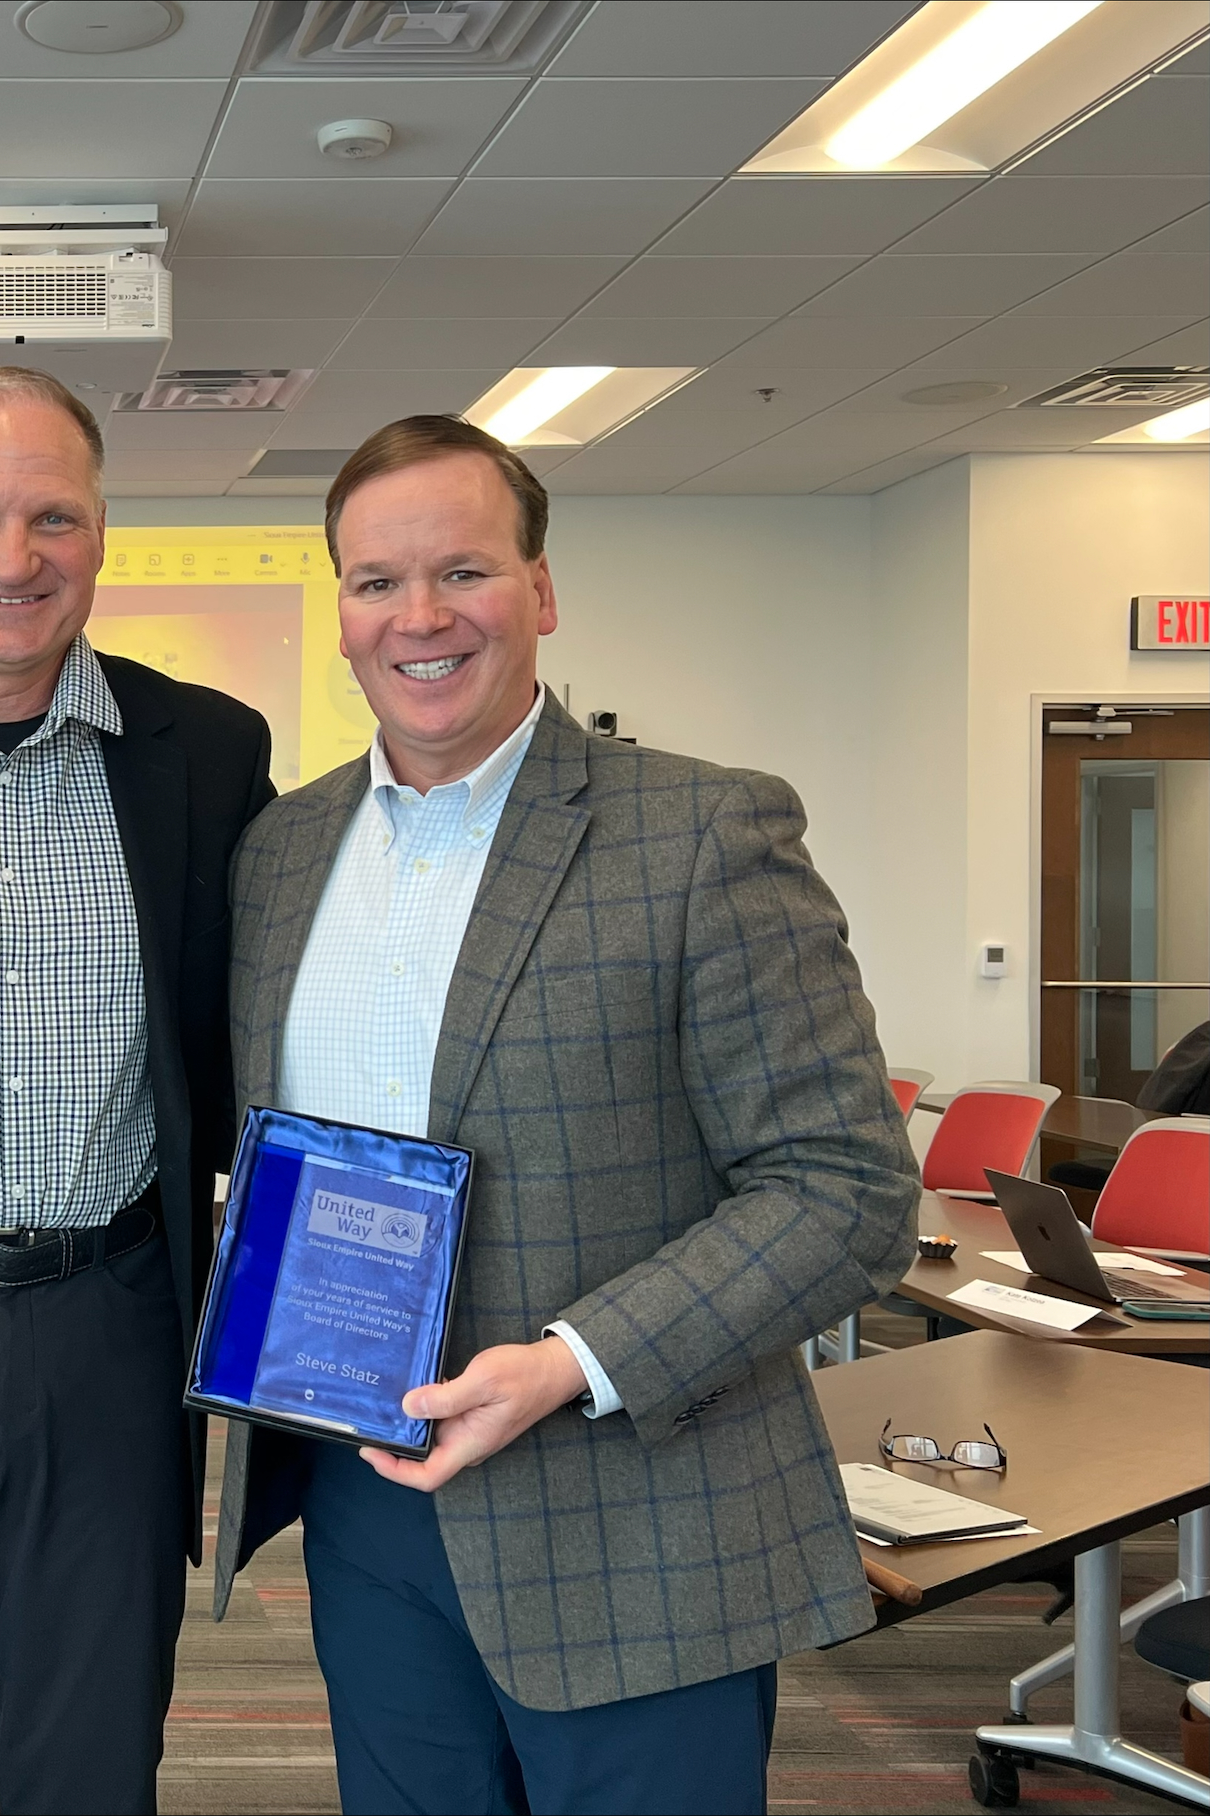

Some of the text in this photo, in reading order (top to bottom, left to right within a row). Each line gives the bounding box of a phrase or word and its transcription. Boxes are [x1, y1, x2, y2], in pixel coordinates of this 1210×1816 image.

[1158, 601, 1210, 643] EXIT
[317, 1195, 376, 1222] United
[337, 1216, 372, 1241] Way
[307, 1238, 415, 1272] Sioux Empire United Way
[291, 1284, 411, 1320] of your years of service to
[318, 1277, 388, 1301] In appreciation
[287, 1294, 411, 1334] Sioux Empire United Way's
[303, 1311, 389, 1341] Board of Directors
[295, 1352, 380, 1386] Steve Statz
